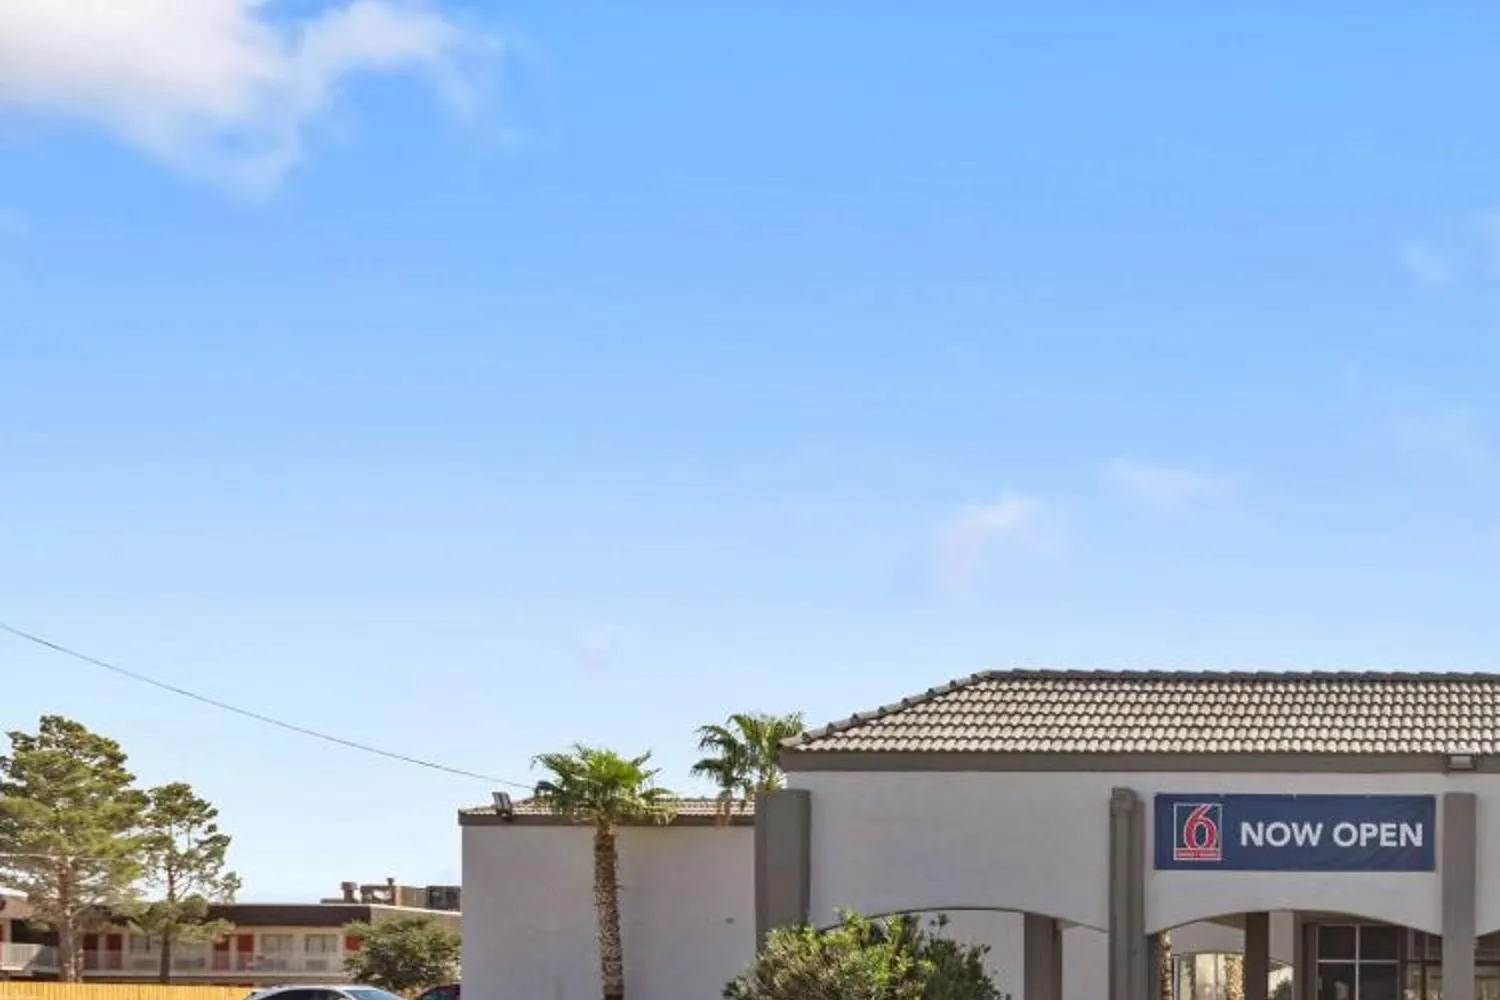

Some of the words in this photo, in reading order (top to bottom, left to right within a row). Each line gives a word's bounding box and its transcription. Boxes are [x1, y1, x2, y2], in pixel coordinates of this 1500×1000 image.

[1183, 803, 1217, 850] 6
[1240, 821, 1324, 847] NOW
[1332, 821, 1423, 847] OPEN
